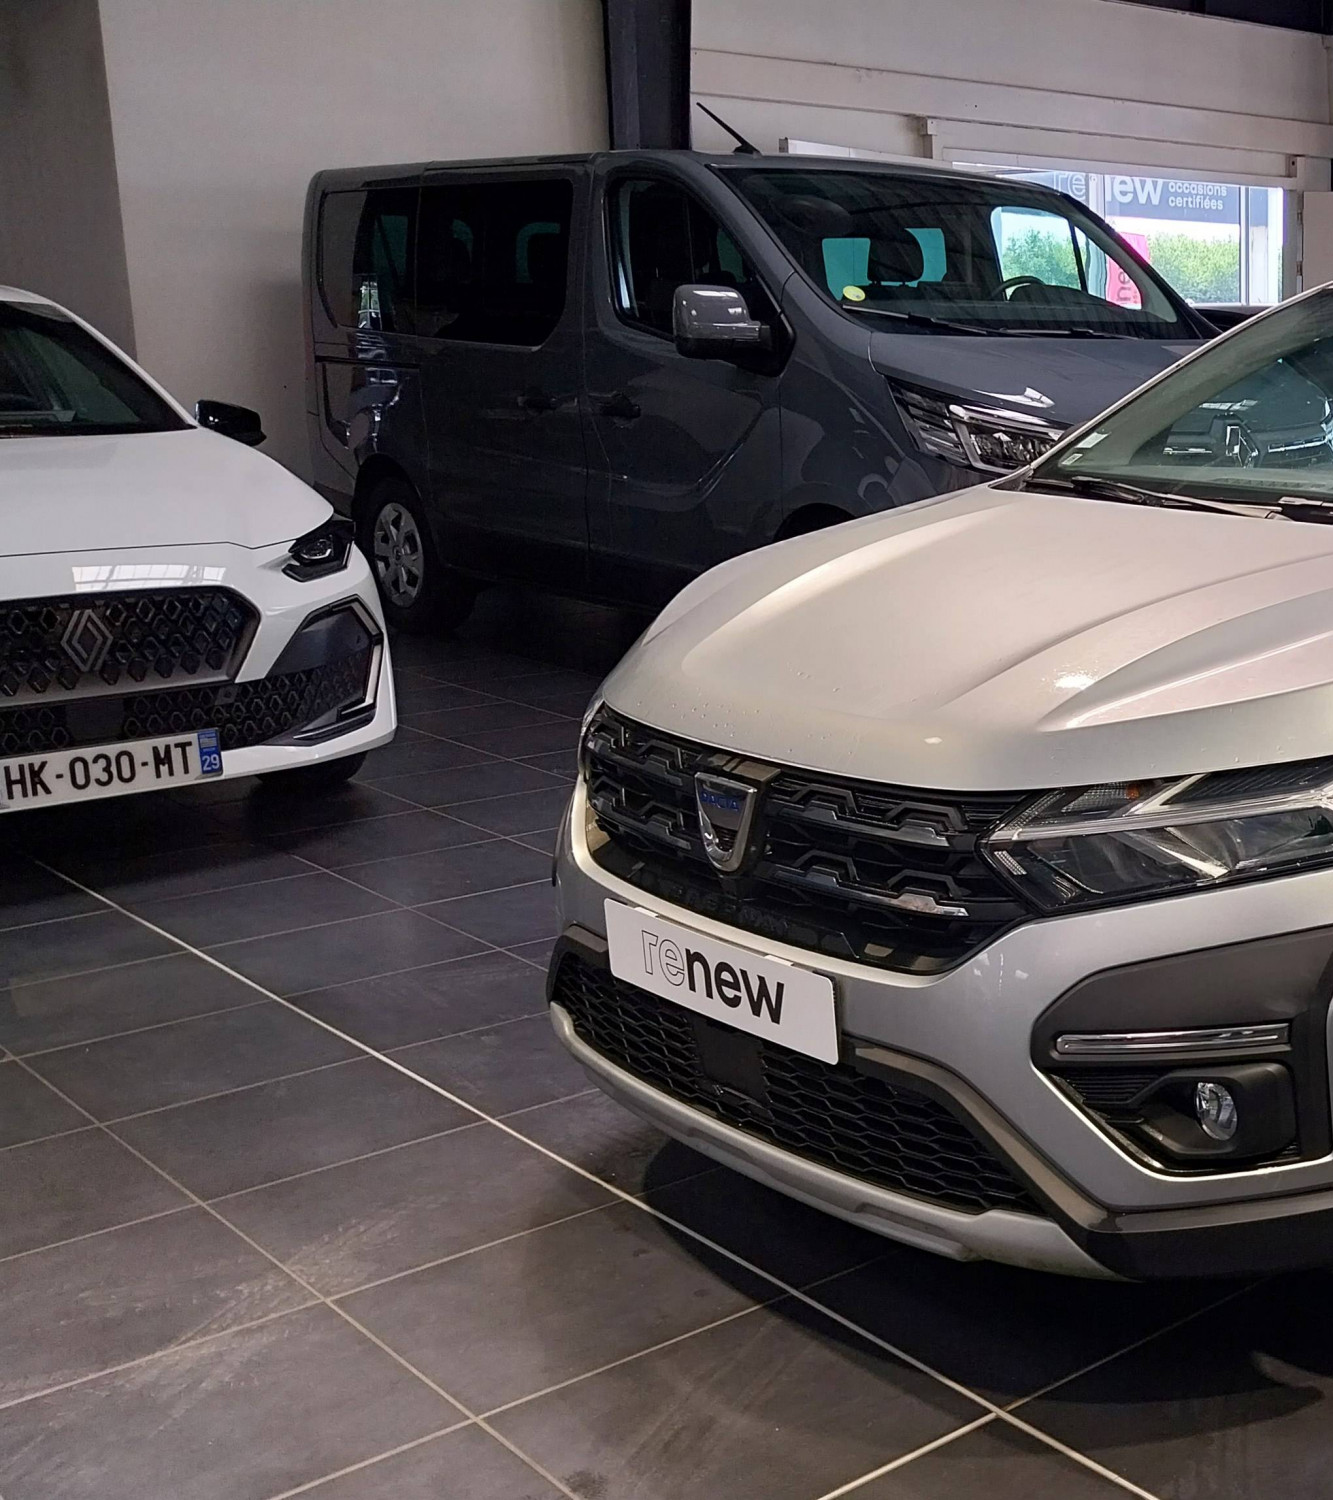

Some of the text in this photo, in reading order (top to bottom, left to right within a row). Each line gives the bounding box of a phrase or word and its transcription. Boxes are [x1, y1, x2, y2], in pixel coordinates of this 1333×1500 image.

[1168, 181, 1228, 197] occasions
[1168, 194, 1224, 210] certifiées
[4, 741, 193, 800] HK-030-MT
[202, 753, 220, 771] 29
[701, 791, 739, 809] DACIA
[641, 930, 785, 1025] renew
